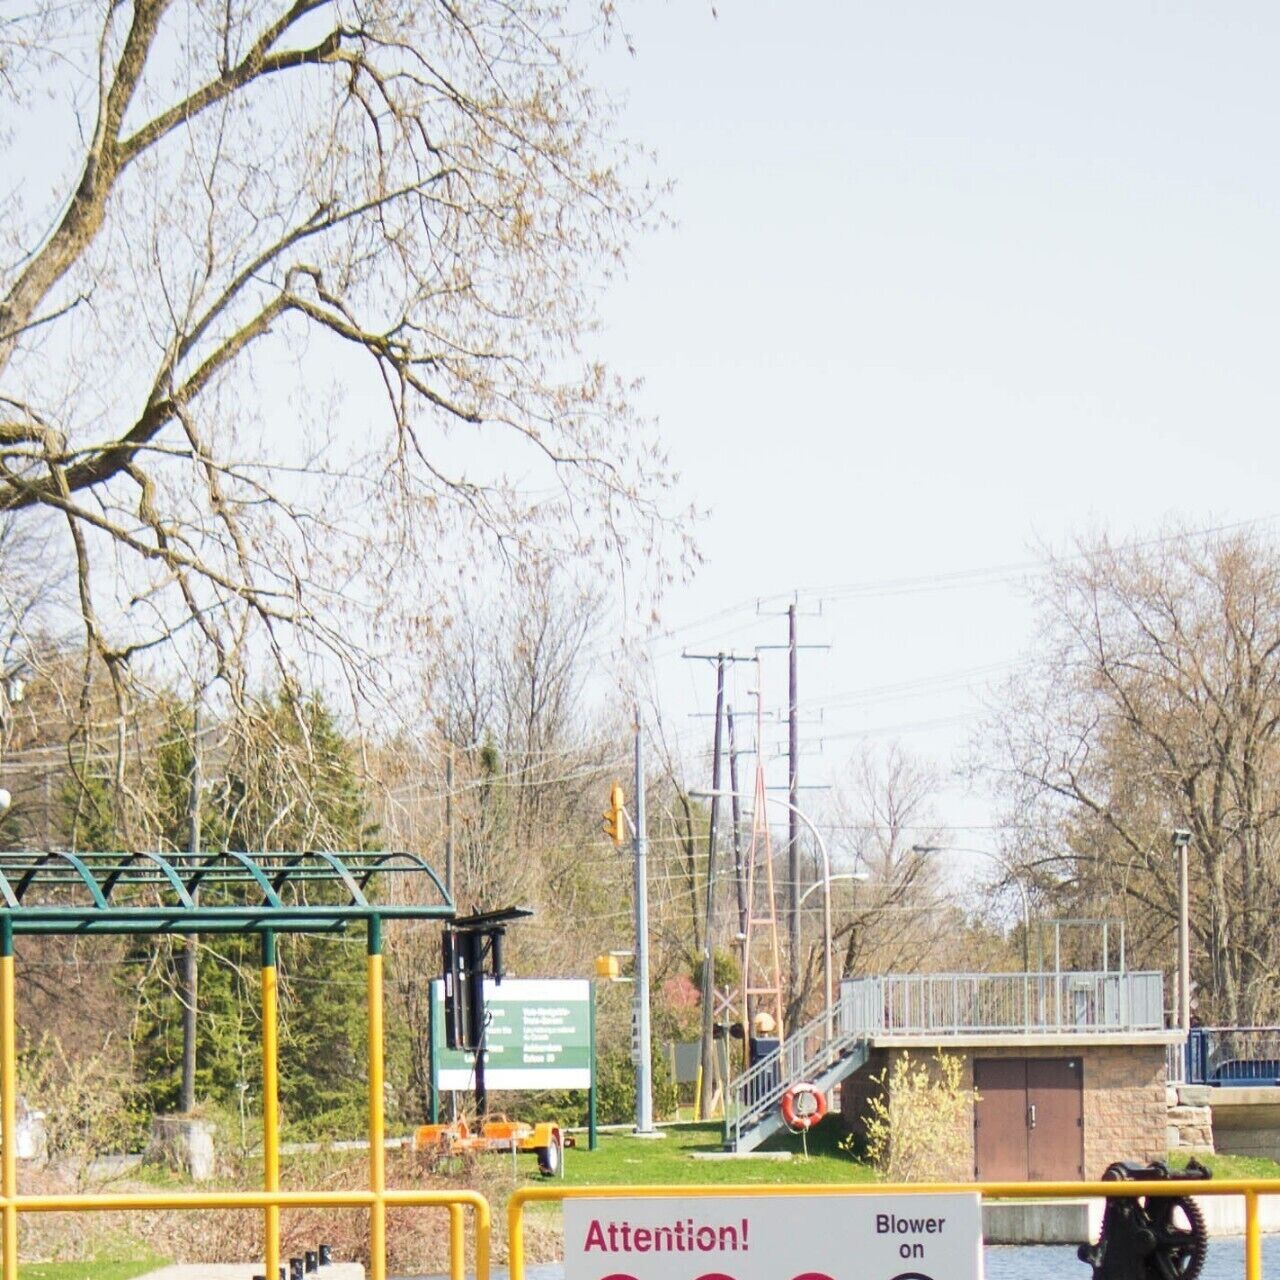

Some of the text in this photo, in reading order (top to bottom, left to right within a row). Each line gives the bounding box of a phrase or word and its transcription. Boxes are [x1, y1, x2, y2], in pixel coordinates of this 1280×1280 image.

[877, 1214, 945, 1233] Blower
[584, 1219, 748, 1252] Attention!
[900, 1244, 924, 1258] on
